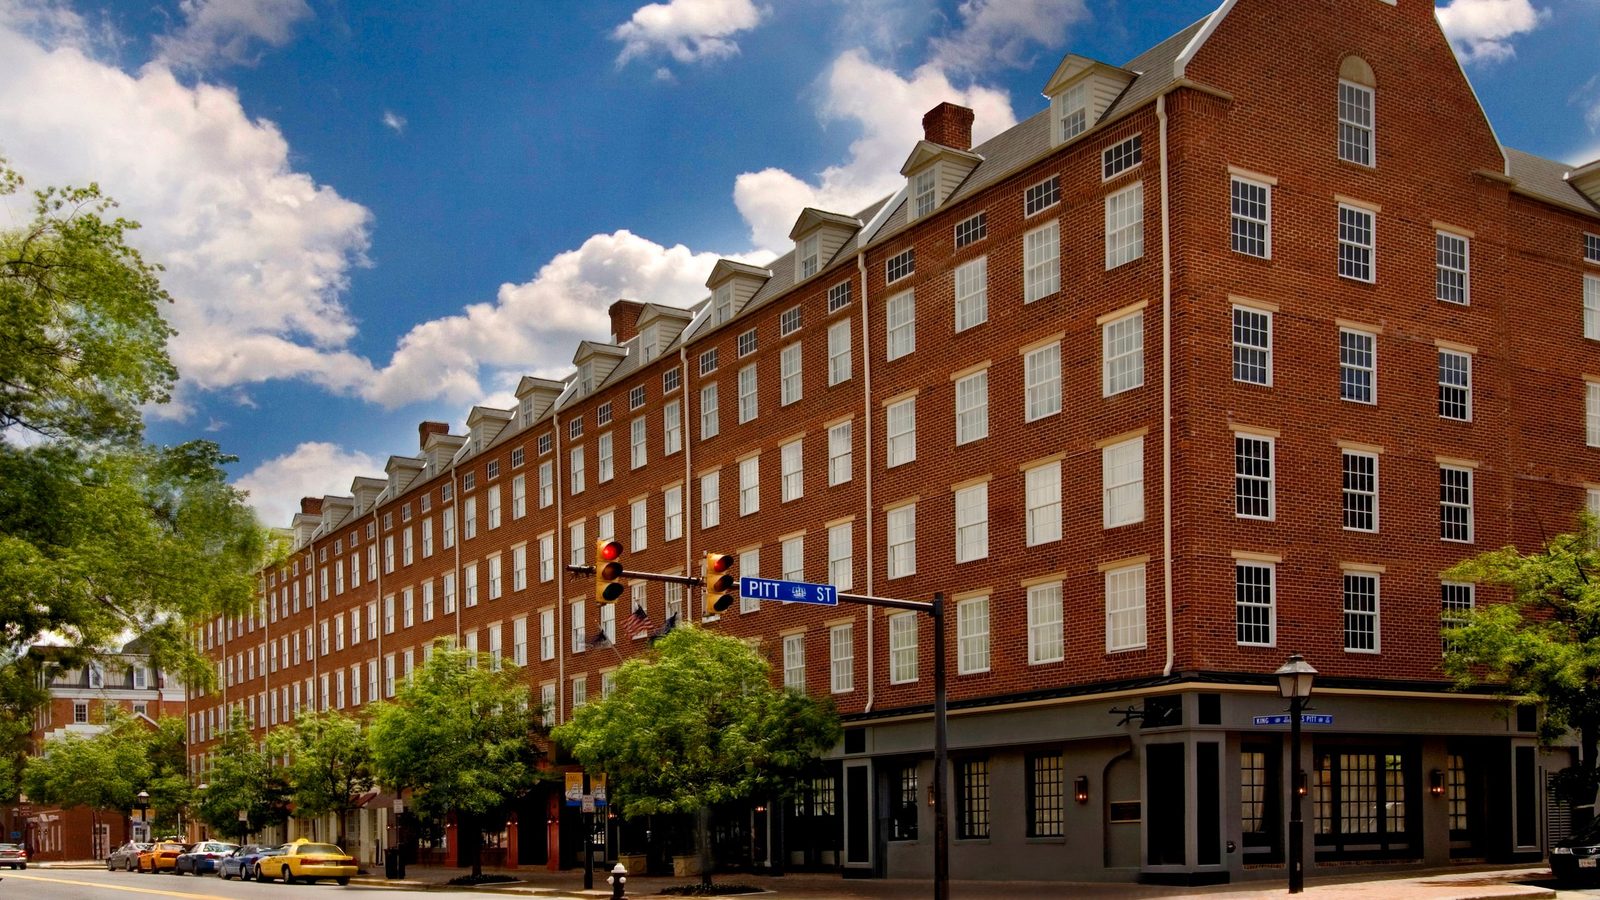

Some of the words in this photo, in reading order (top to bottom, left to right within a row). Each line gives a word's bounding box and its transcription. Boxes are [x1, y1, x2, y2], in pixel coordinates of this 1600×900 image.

[749, 580, 780, 598] PITT
[816, 586, 832, 602] ST
[1306, 715, 1317, 723] PITT
